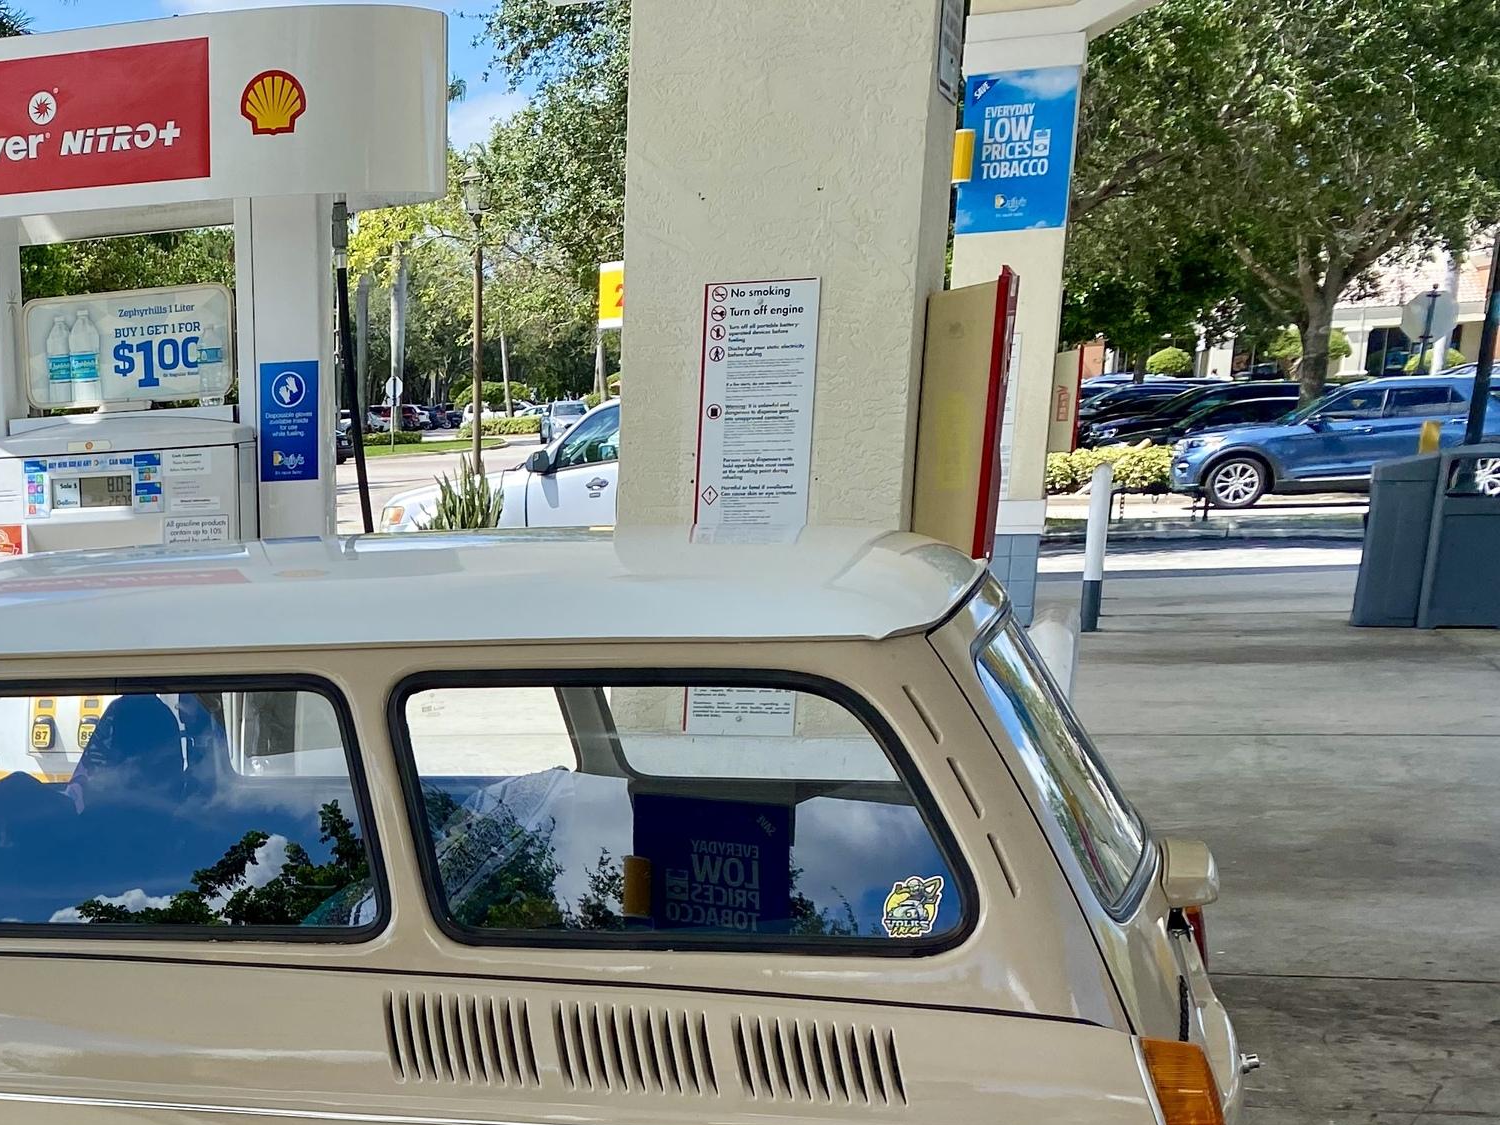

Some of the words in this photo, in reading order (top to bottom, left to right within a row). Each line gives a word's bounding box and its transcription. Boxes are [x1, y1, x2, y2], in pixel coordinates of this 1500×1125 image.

[974, 81, 990, 100] SAVE
[985, 103, 1035, 118] EVERYDAY
[983, 115, 1034, 143] LOW
[982, 141, 1031, 161] PRICES
[981, 158, 1049, 180] TOBACCO
[614, 284, 625, 307] 2
[731, 288, 745, 298] No
[749, 286, 790, 297] smoking
[118, 306, 167, 318] Zephyrhills
[169, 304, 173, 313] 1
[175, 304, 195, 312] Liter
[730, 307, 750, 316] Turn
[754, 305, 767, 315] off
[770, 304, 804, 316] engine
[115, 326, 138, 338] BUY
[140, 326, 144, 336] 1
[147, 324, 168, 335] GET
[171, 323, 176, 333] 1
[179, 321, 201, 333] FOR
[175, 519, 200, 528] gasoline
[201, 519, 226, 527] products
[34, 731, 48, 740] 87
[884, 920, 930, 931] VOLKS
